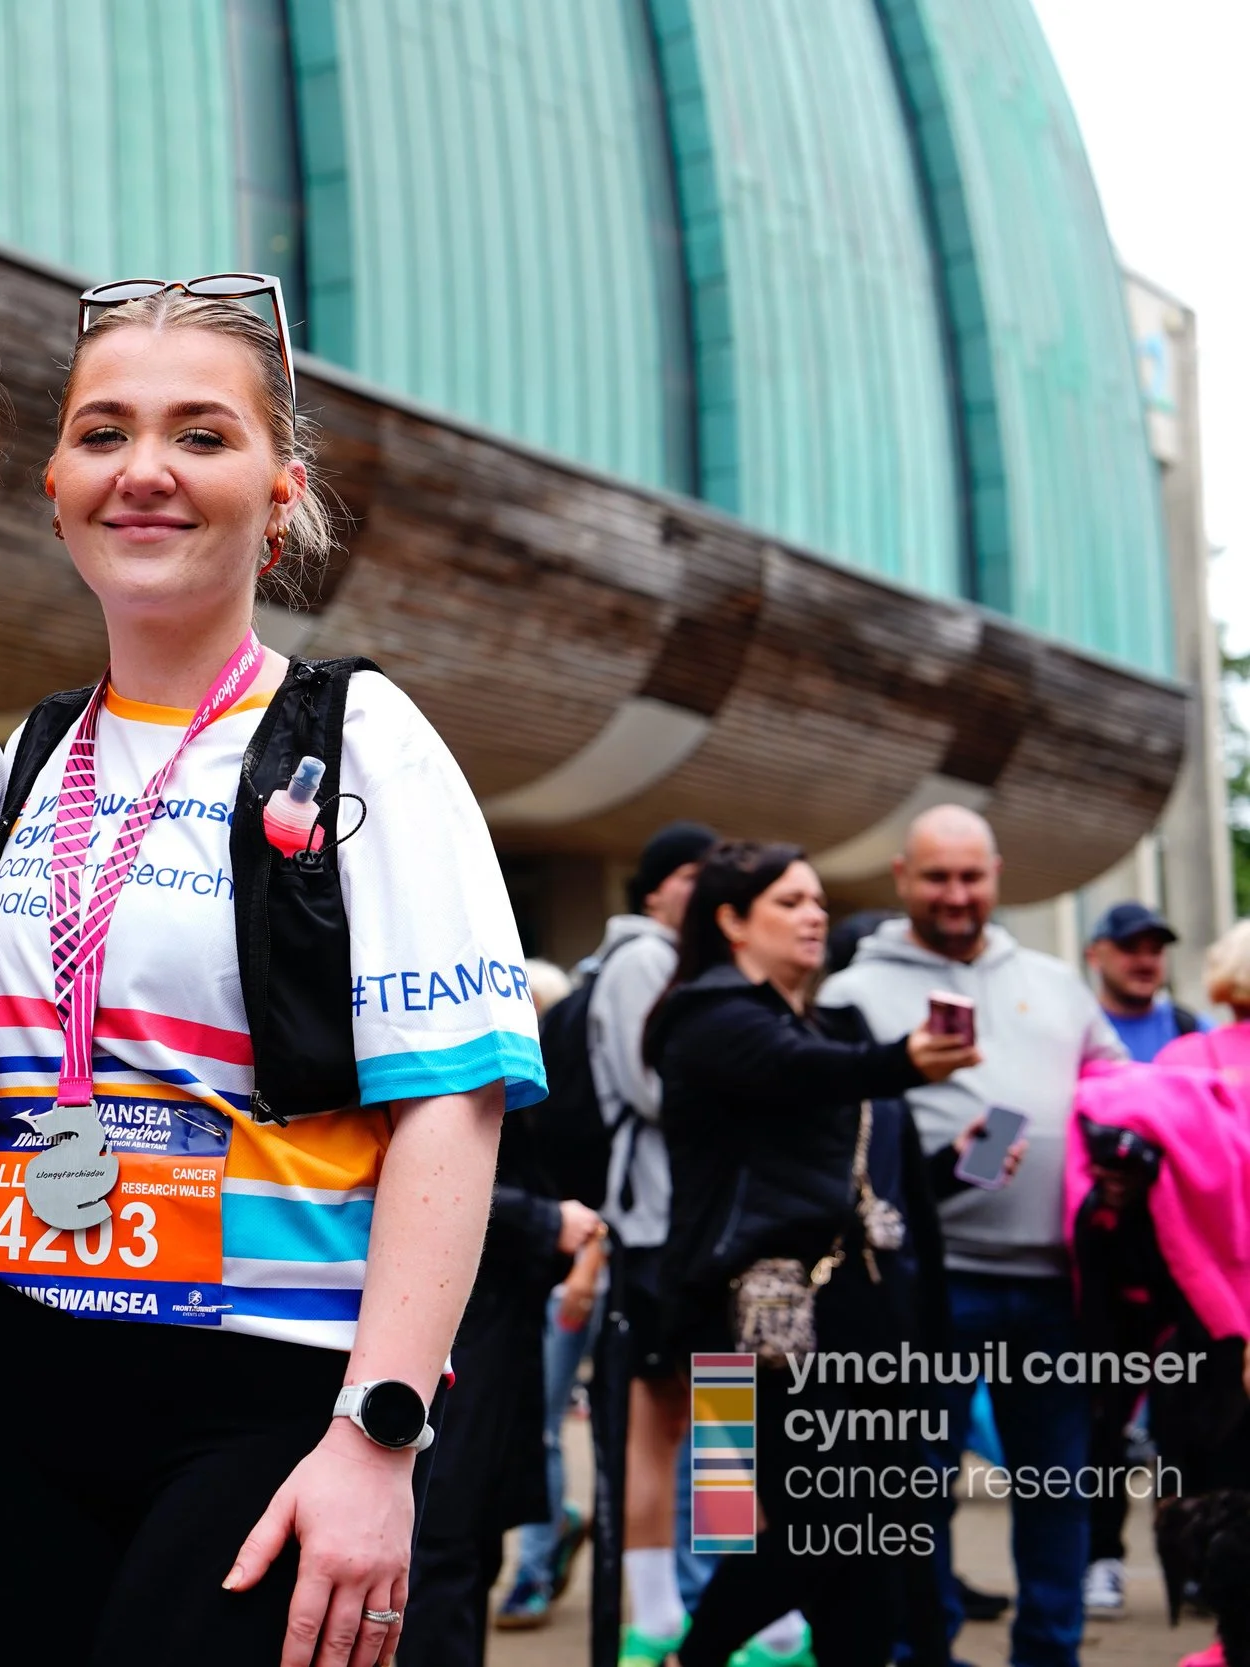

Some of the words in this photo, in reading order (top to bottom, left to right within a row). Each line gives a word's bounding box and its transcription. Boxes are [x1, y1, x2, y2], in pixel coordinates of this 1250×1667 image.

[92, 864, 235, 901] rsearch
[351, 956, 533, 1017] #TEAMCR
[97, 1103, 172, 1126] ANSEA
[172, 1167, 217, 1181] CANCER
[121, 1182, 178, 1197] RESEARCH
[179, 1183, 216, 1199] WALES
